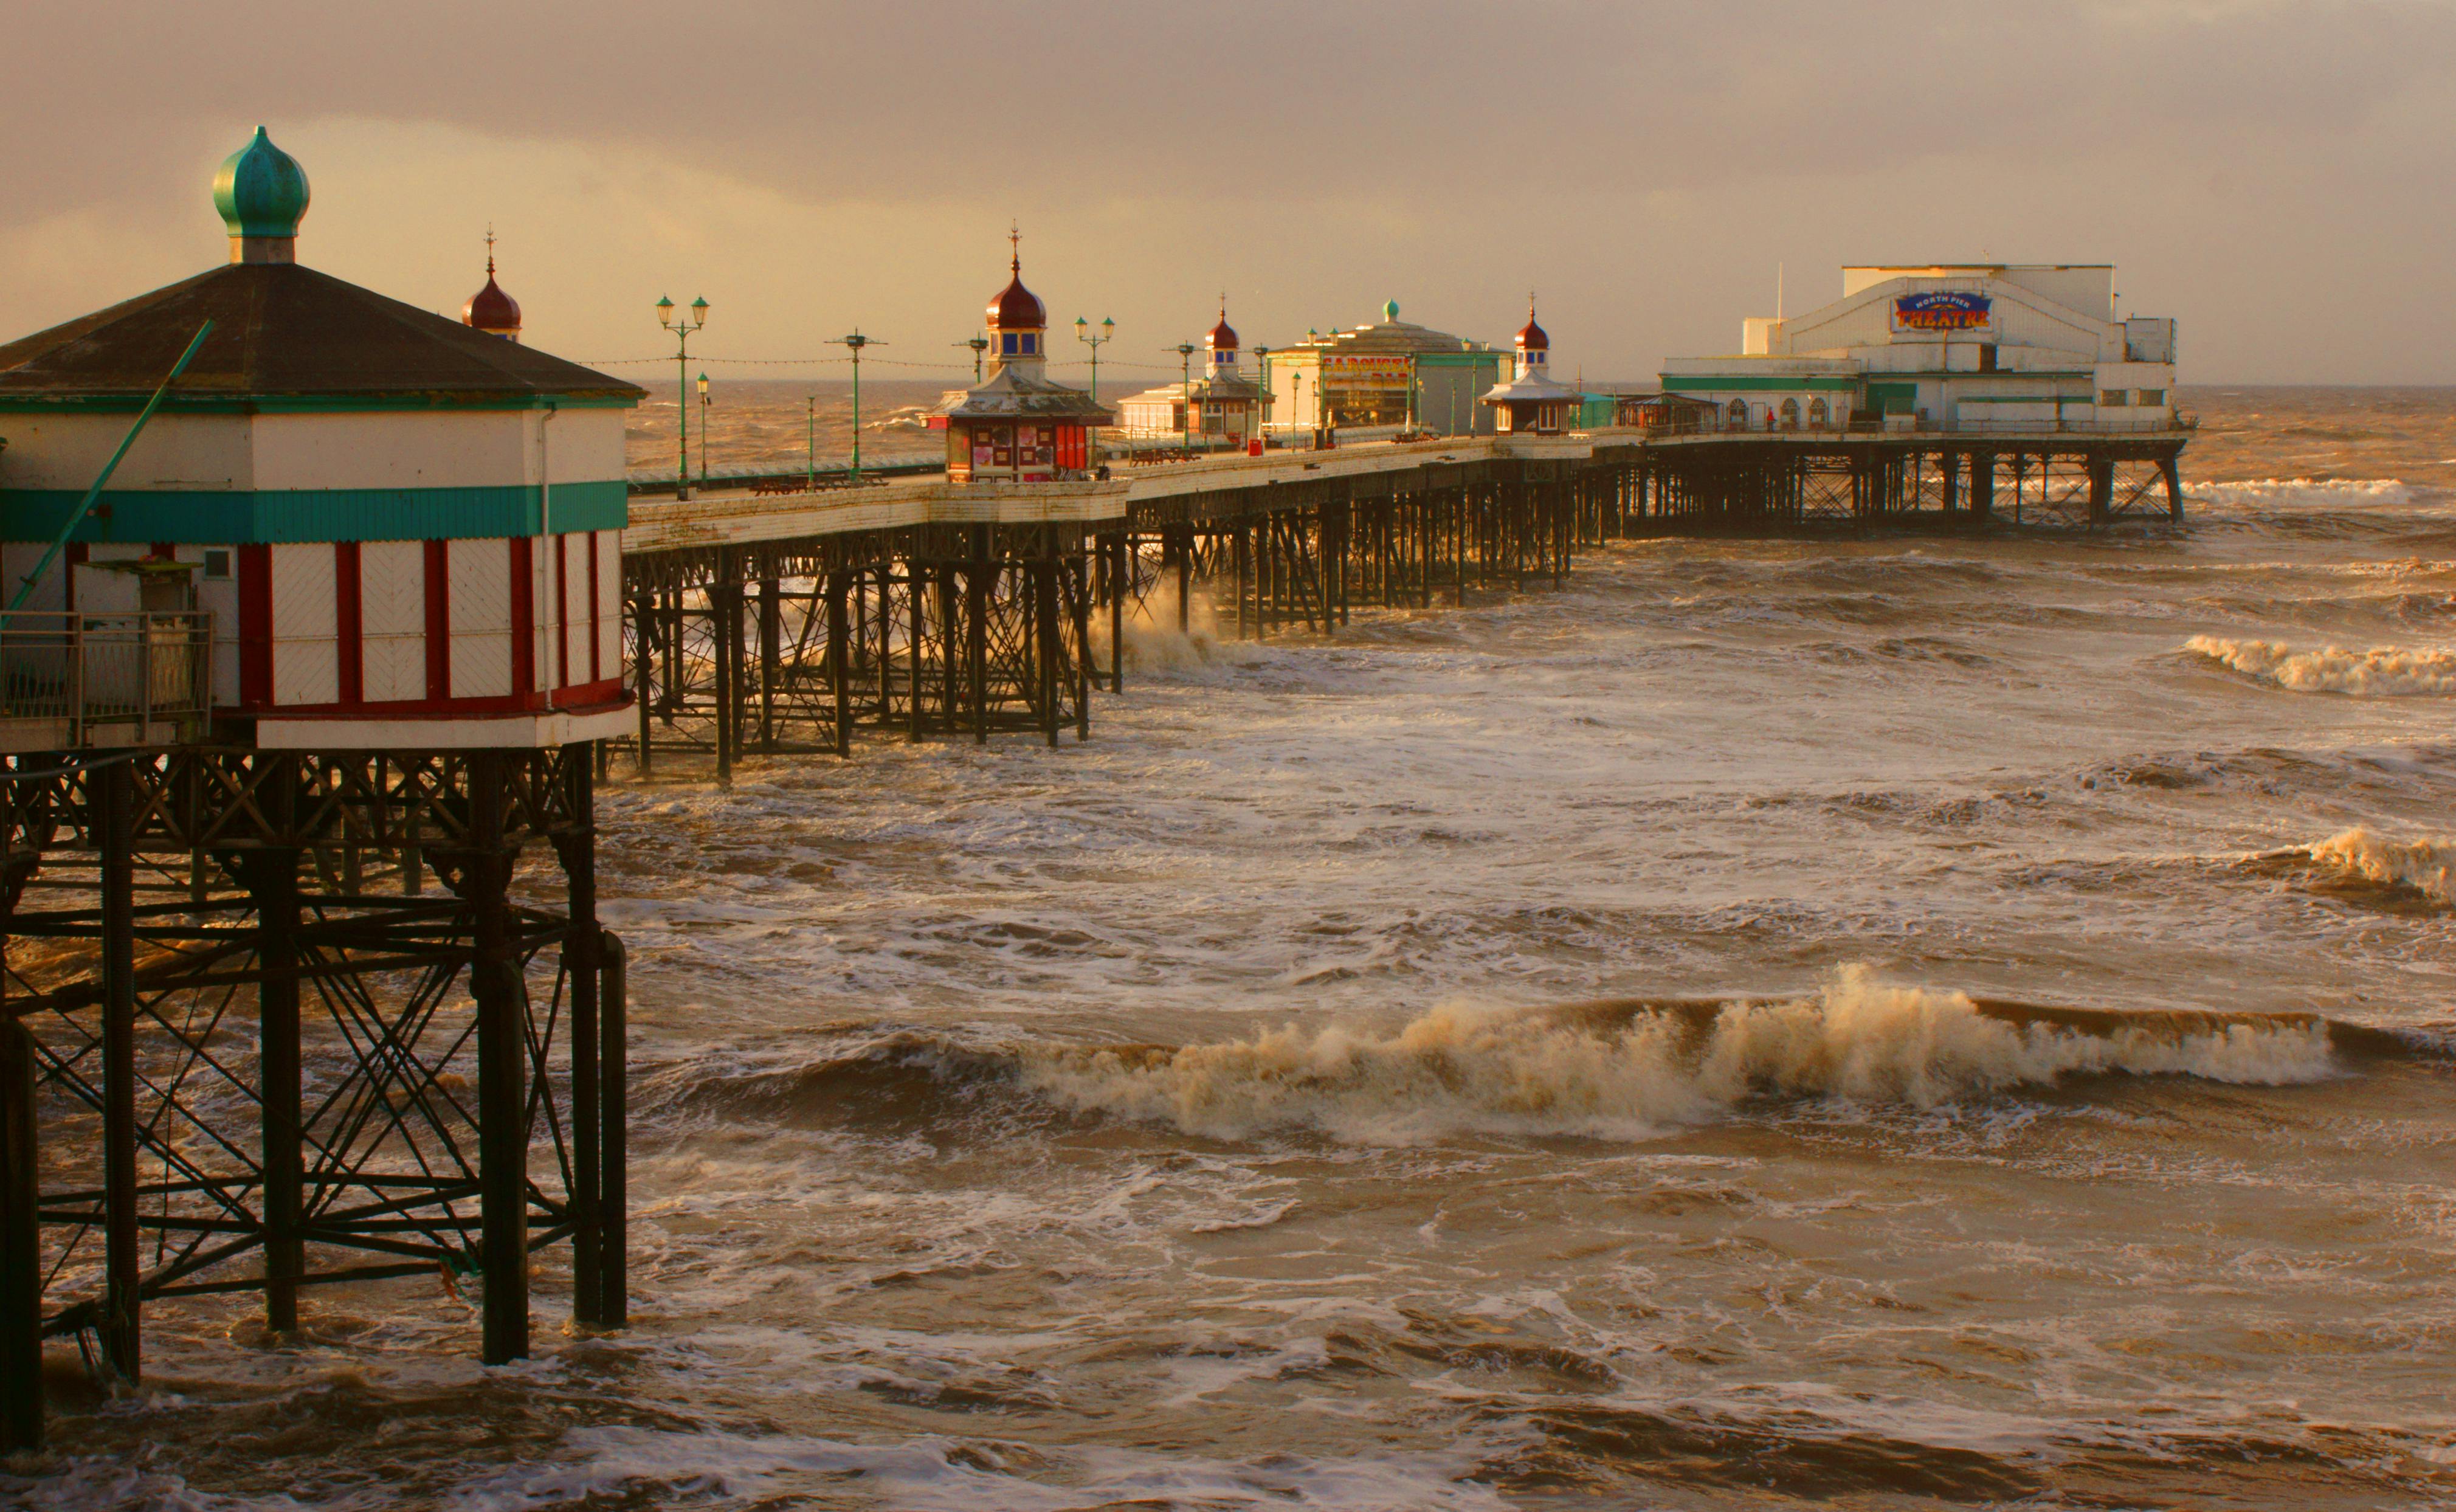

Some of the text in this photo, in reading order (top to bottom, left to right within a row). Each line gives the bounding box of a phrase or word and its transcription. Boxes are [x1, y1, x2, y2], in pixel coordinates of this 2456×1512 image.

[1916, 296, 1970, 309] NORTH PIER
[1895, 311, 1989, 327] THEATRE
